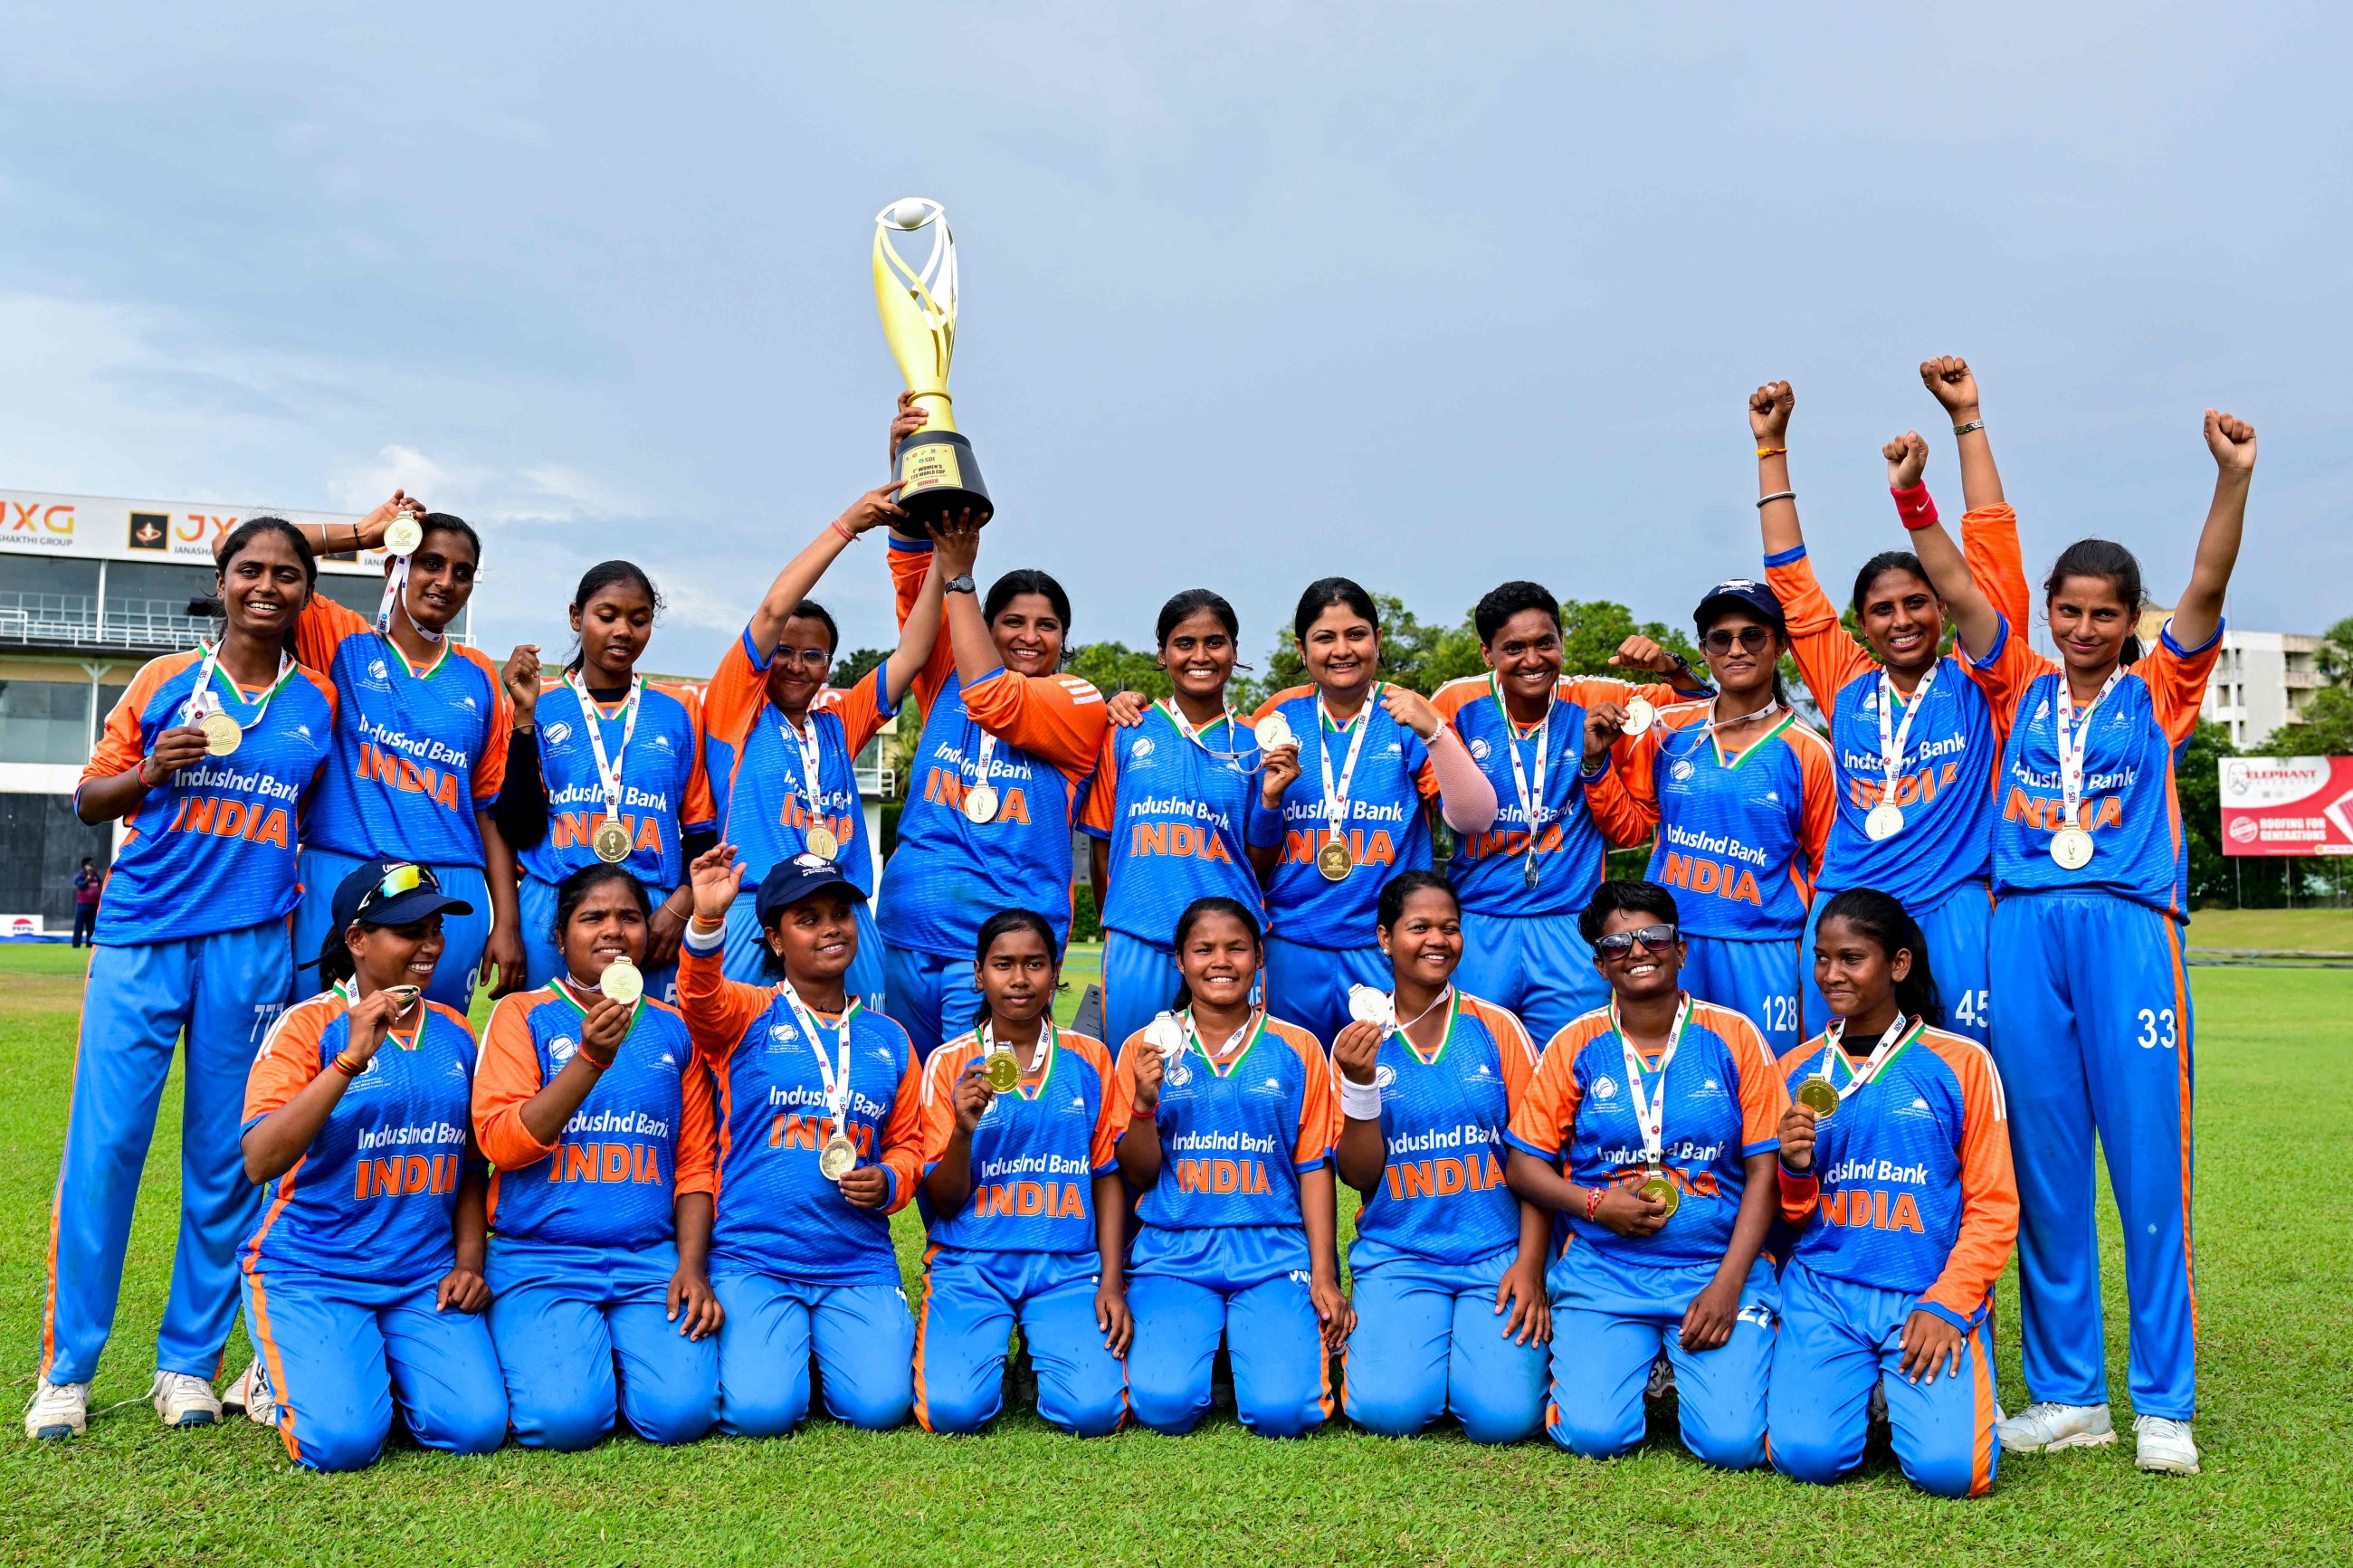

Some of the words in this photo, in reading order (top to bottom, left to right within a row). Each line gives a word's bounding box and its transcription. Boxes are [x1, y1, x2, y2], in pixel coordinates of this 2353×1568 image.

[919, 464, 943, 472] WOMEN'S
[917, 478, 939, 487] WINNER
[0, 501, 75, 534] XG
[176, 514, 237, 542] JX
[39, 537, 73, 546] GROUP
[198, 670, 208, 679] SBI
[1919, 732, 1966, 762] Bank
[175, 765, 255, 792] IndusInd
[356, 743, 457, 812] INDIA
[2087, 766, 2136, 791] Bank
[2246, 770, 2317, 780] ELEPHANT
[624, 787, 667, 812] Bank
[1129, 796, 1196, 818] IndusInd
[1352, 801, 1403, 822] Bank
[169, 796, 288, 850] INDIA
[779, 792, 853, 846] INIA
[2305, 817, 2327, 830] FOR
[1130, 822, 1234, 864] INDIA
[1464, 823, 1564, 860] INDA
[1667, 823, 1729, 854] IdusInd
[1728, 840, 1767, 866] Bank
[793, 1005, 803, 1015] SBI
[1762, 994, 1797, 1031] 128
[1955, 989, 1989, 1028] 45
[1042, 1031, 1050, 1043] SBI
[1893, 1021, 1903, 1032] SBI
[2138, 1008, 2176, 1049] 33
[769, 1085, 852, 1107] IndusI
[562, 1109, 635, 1134] dusInd
[357, 1122, 436, 1150] IndusInd
[1173, 1130, 1238, 1151] IndusInd
[1241, 1132, 1277, 1154] Bank
[1387, 1125, 1461, 1155] ndusInd
[1464, 1125, 1500, 1145] Bak
[548, 1143, 662, 1185] INDIA
[1680, 1140, 1725, 1162] Bank
[1049, 1155, 1090, 1175] Bank
[1177, 1159, 1273, 1195] INDIA
[1386, 1151, 1508, 1201] INDIA
[1878, 1160, 1929, 1185] Bank
[975, 1181, 1086, 1219] INDIA
[1819, 1190, 1925, 1233] NDIA
